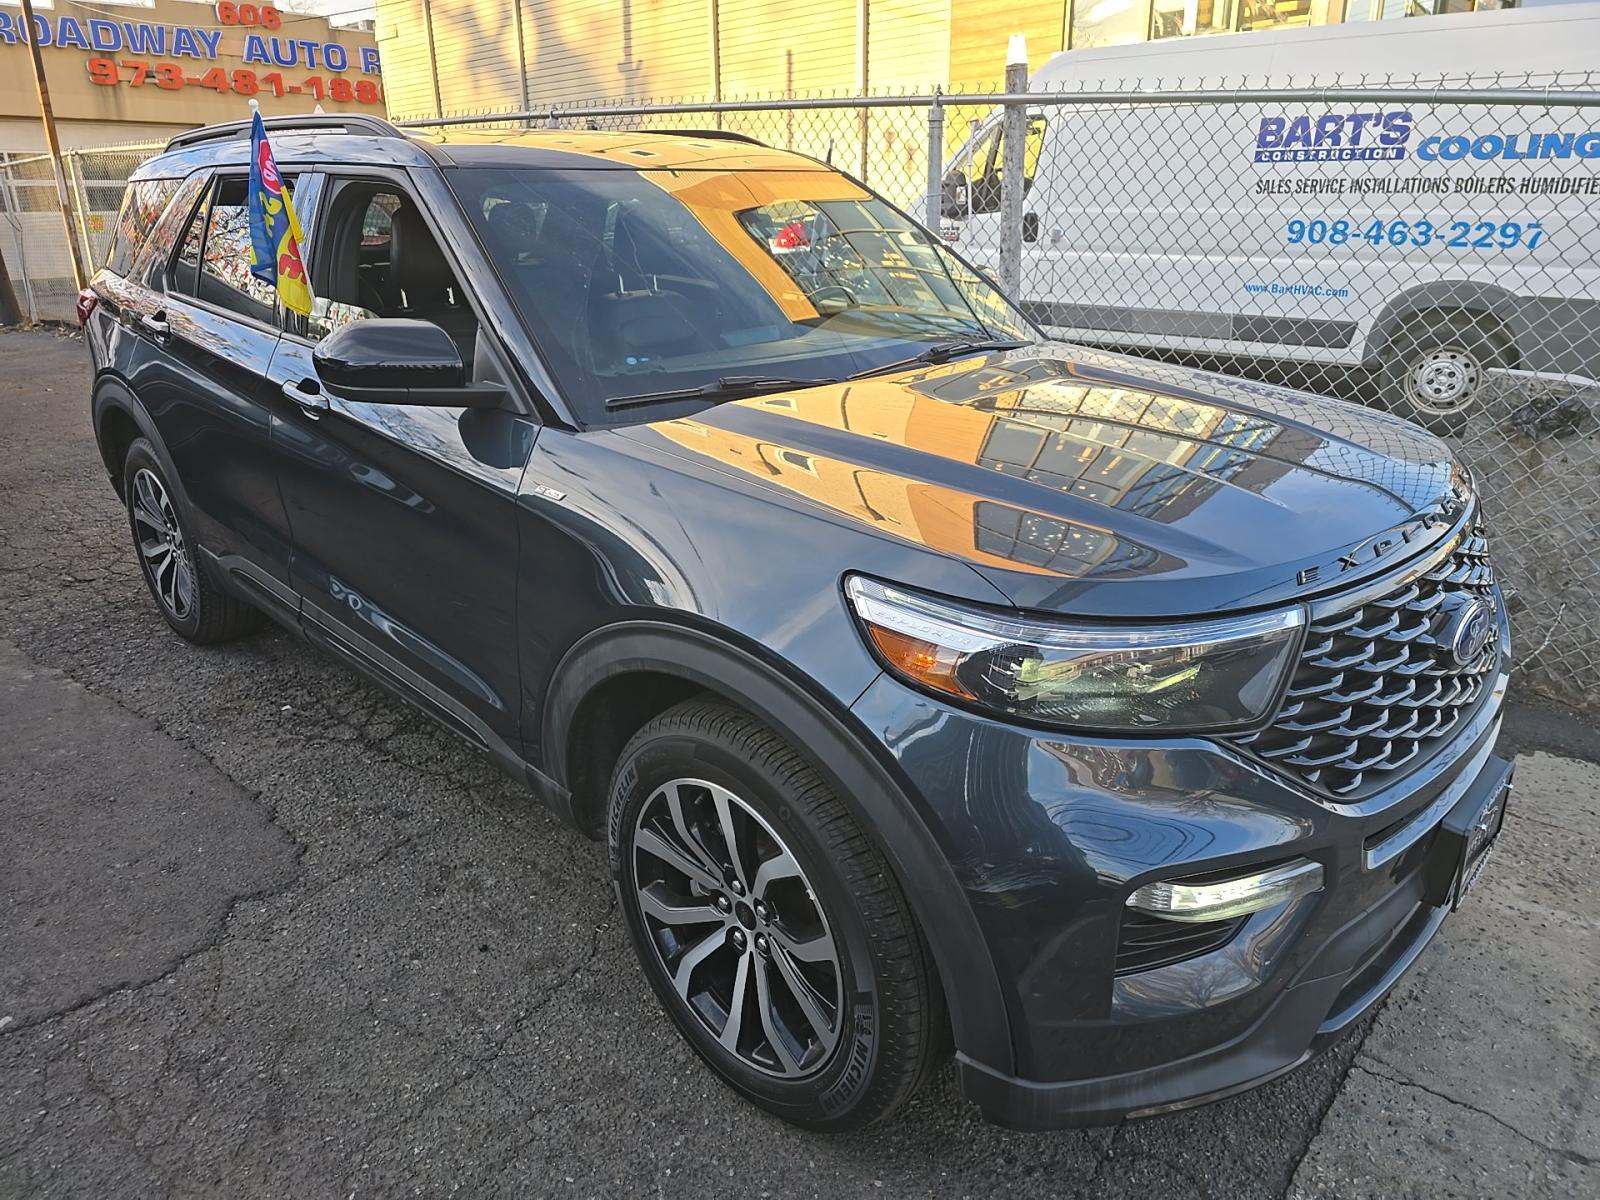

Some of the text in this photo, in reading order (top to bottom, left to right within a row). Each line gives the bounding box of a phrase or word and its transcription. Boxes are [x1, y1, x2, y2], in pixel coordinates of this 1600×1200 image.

[216, 1, 281, 30] 606
[243, 35, 348, 73] AUTO
[87, 58, 385, 105] 973-481-188
[1256, 111, 1413, 149] BART'S
[1261, 148, 1397, 161] CONSTRUCTION
[1416, 131, 1600, 161] COOLING
[1256, 178, 1292, 194] SALES
[1294, 178, 1347, 194] SERVICE
[1349, 177, 1450, 194] INSTALLATIONS
[1454, 177, 1516, 194] BOILERS
[1286, 219, 1543, 249] 908-463-2297
[1244, 283, 1348, 298] www.BartHVAC.com
